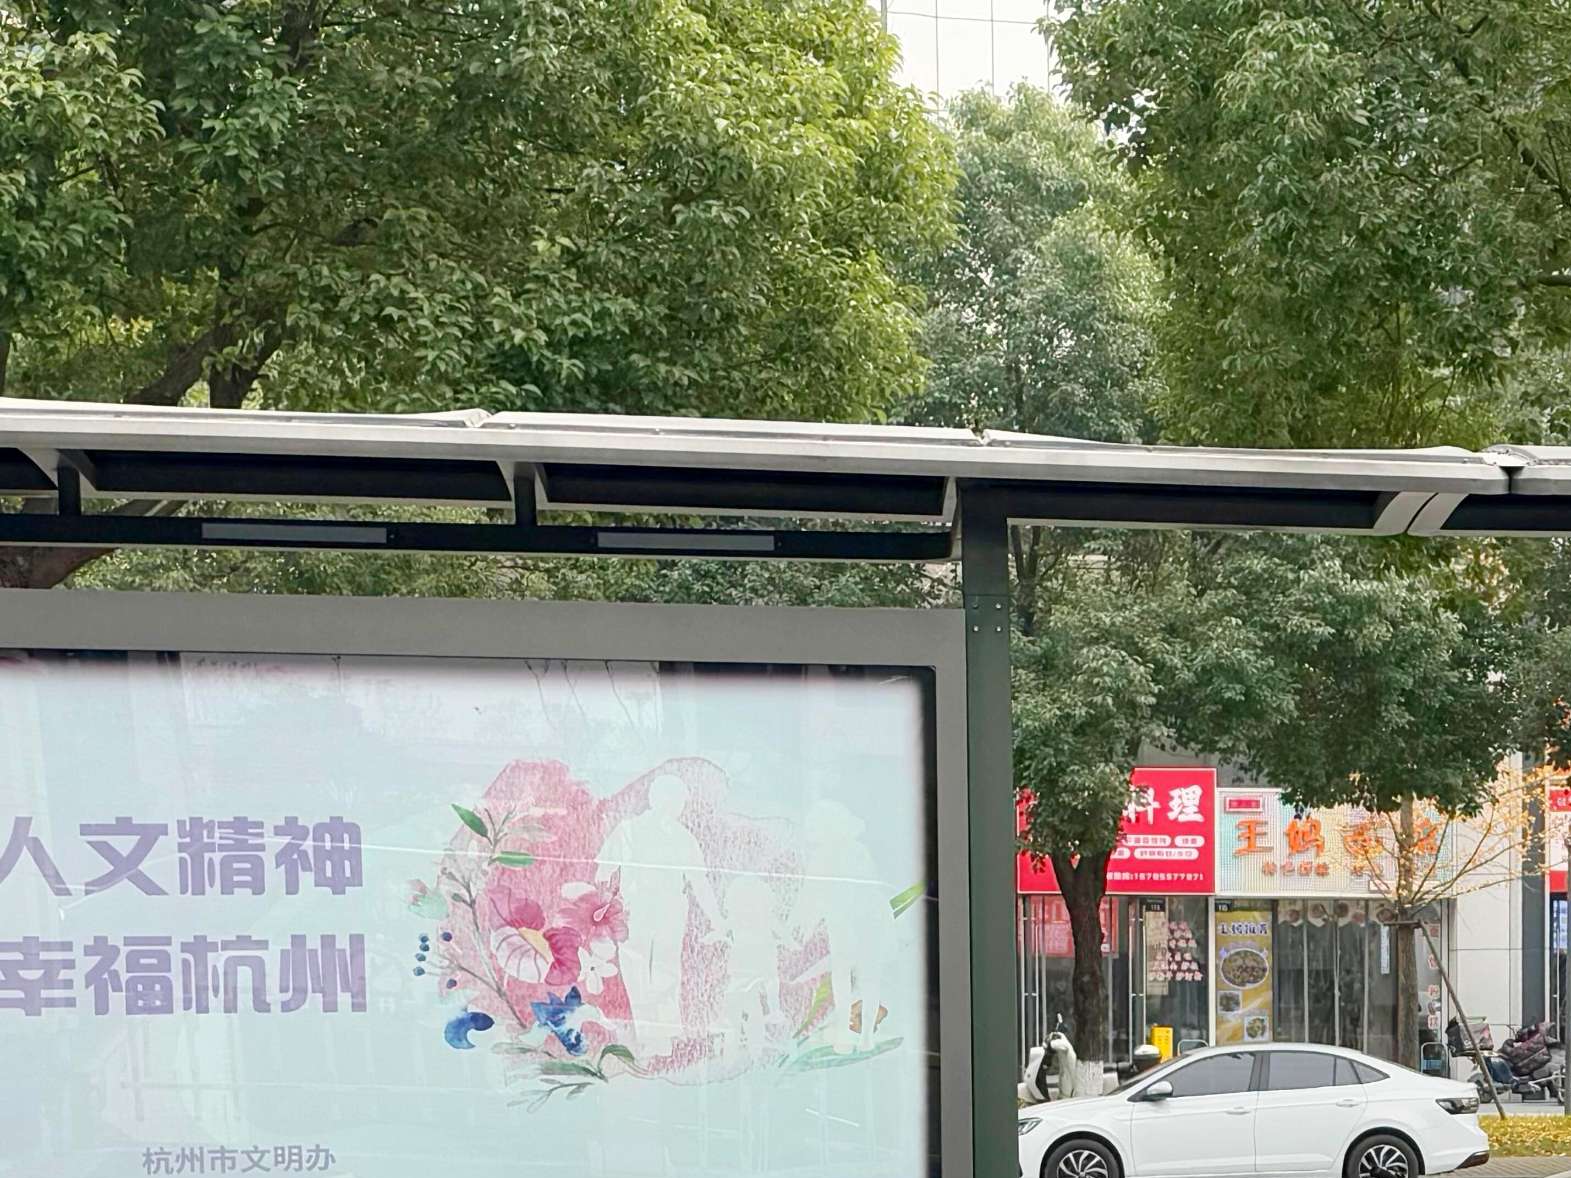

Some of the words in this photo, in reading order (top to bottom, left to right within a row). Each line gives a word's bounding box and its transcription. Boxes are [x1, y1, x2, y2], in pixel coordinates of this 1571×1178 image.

[0, 816, 363, 896] 人文精神
[0, 934, 367, 1016] 幸福杭州
[142, 1143, 336, 1176] 杭州市文明办
